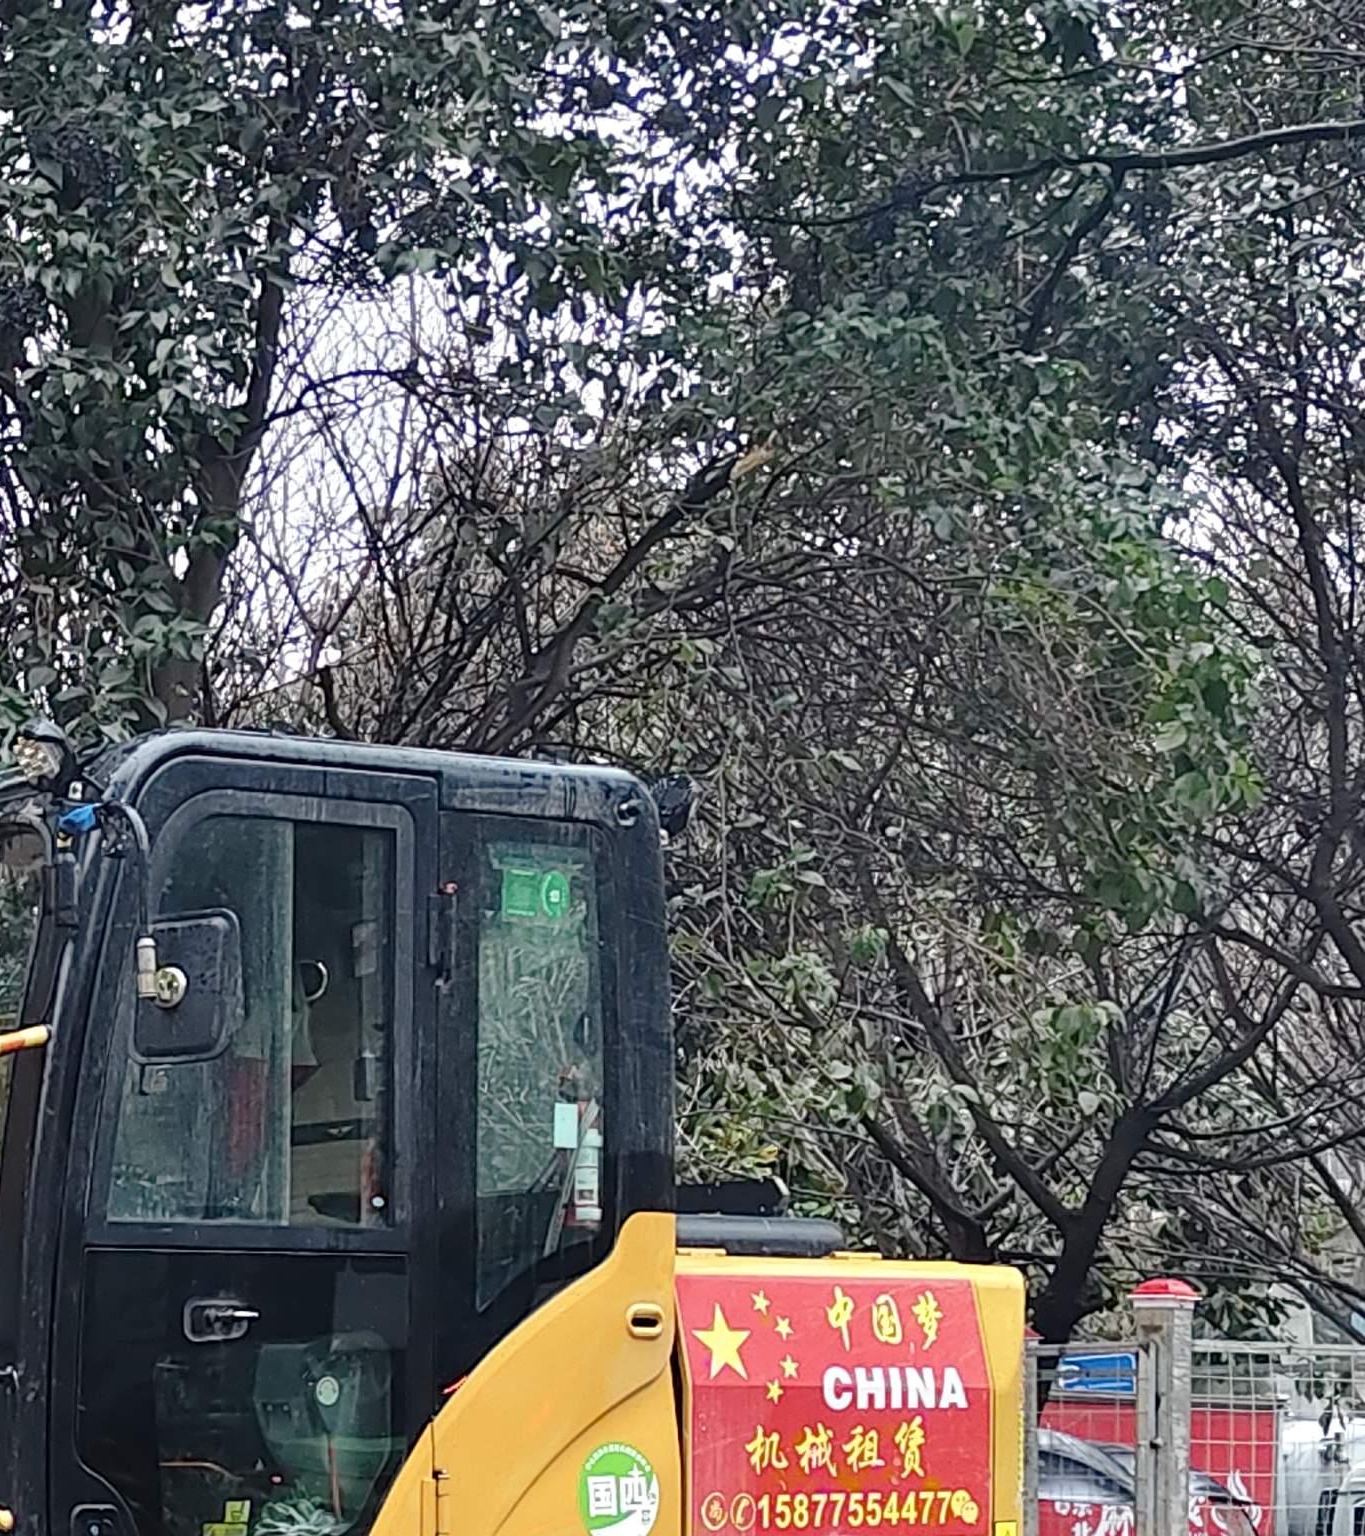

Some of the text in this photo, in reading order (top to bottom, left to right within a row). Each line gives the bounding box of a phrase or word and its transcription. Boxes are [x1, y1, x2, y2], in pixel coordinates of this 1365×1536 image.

[826, 1286, 943, 1352] 中国梦
[822, 1365, 969, 1411] CHINA
[744, 1415, 925, 1478] 机械租赁
[757, 1490, 953, 1528] 15877554477
